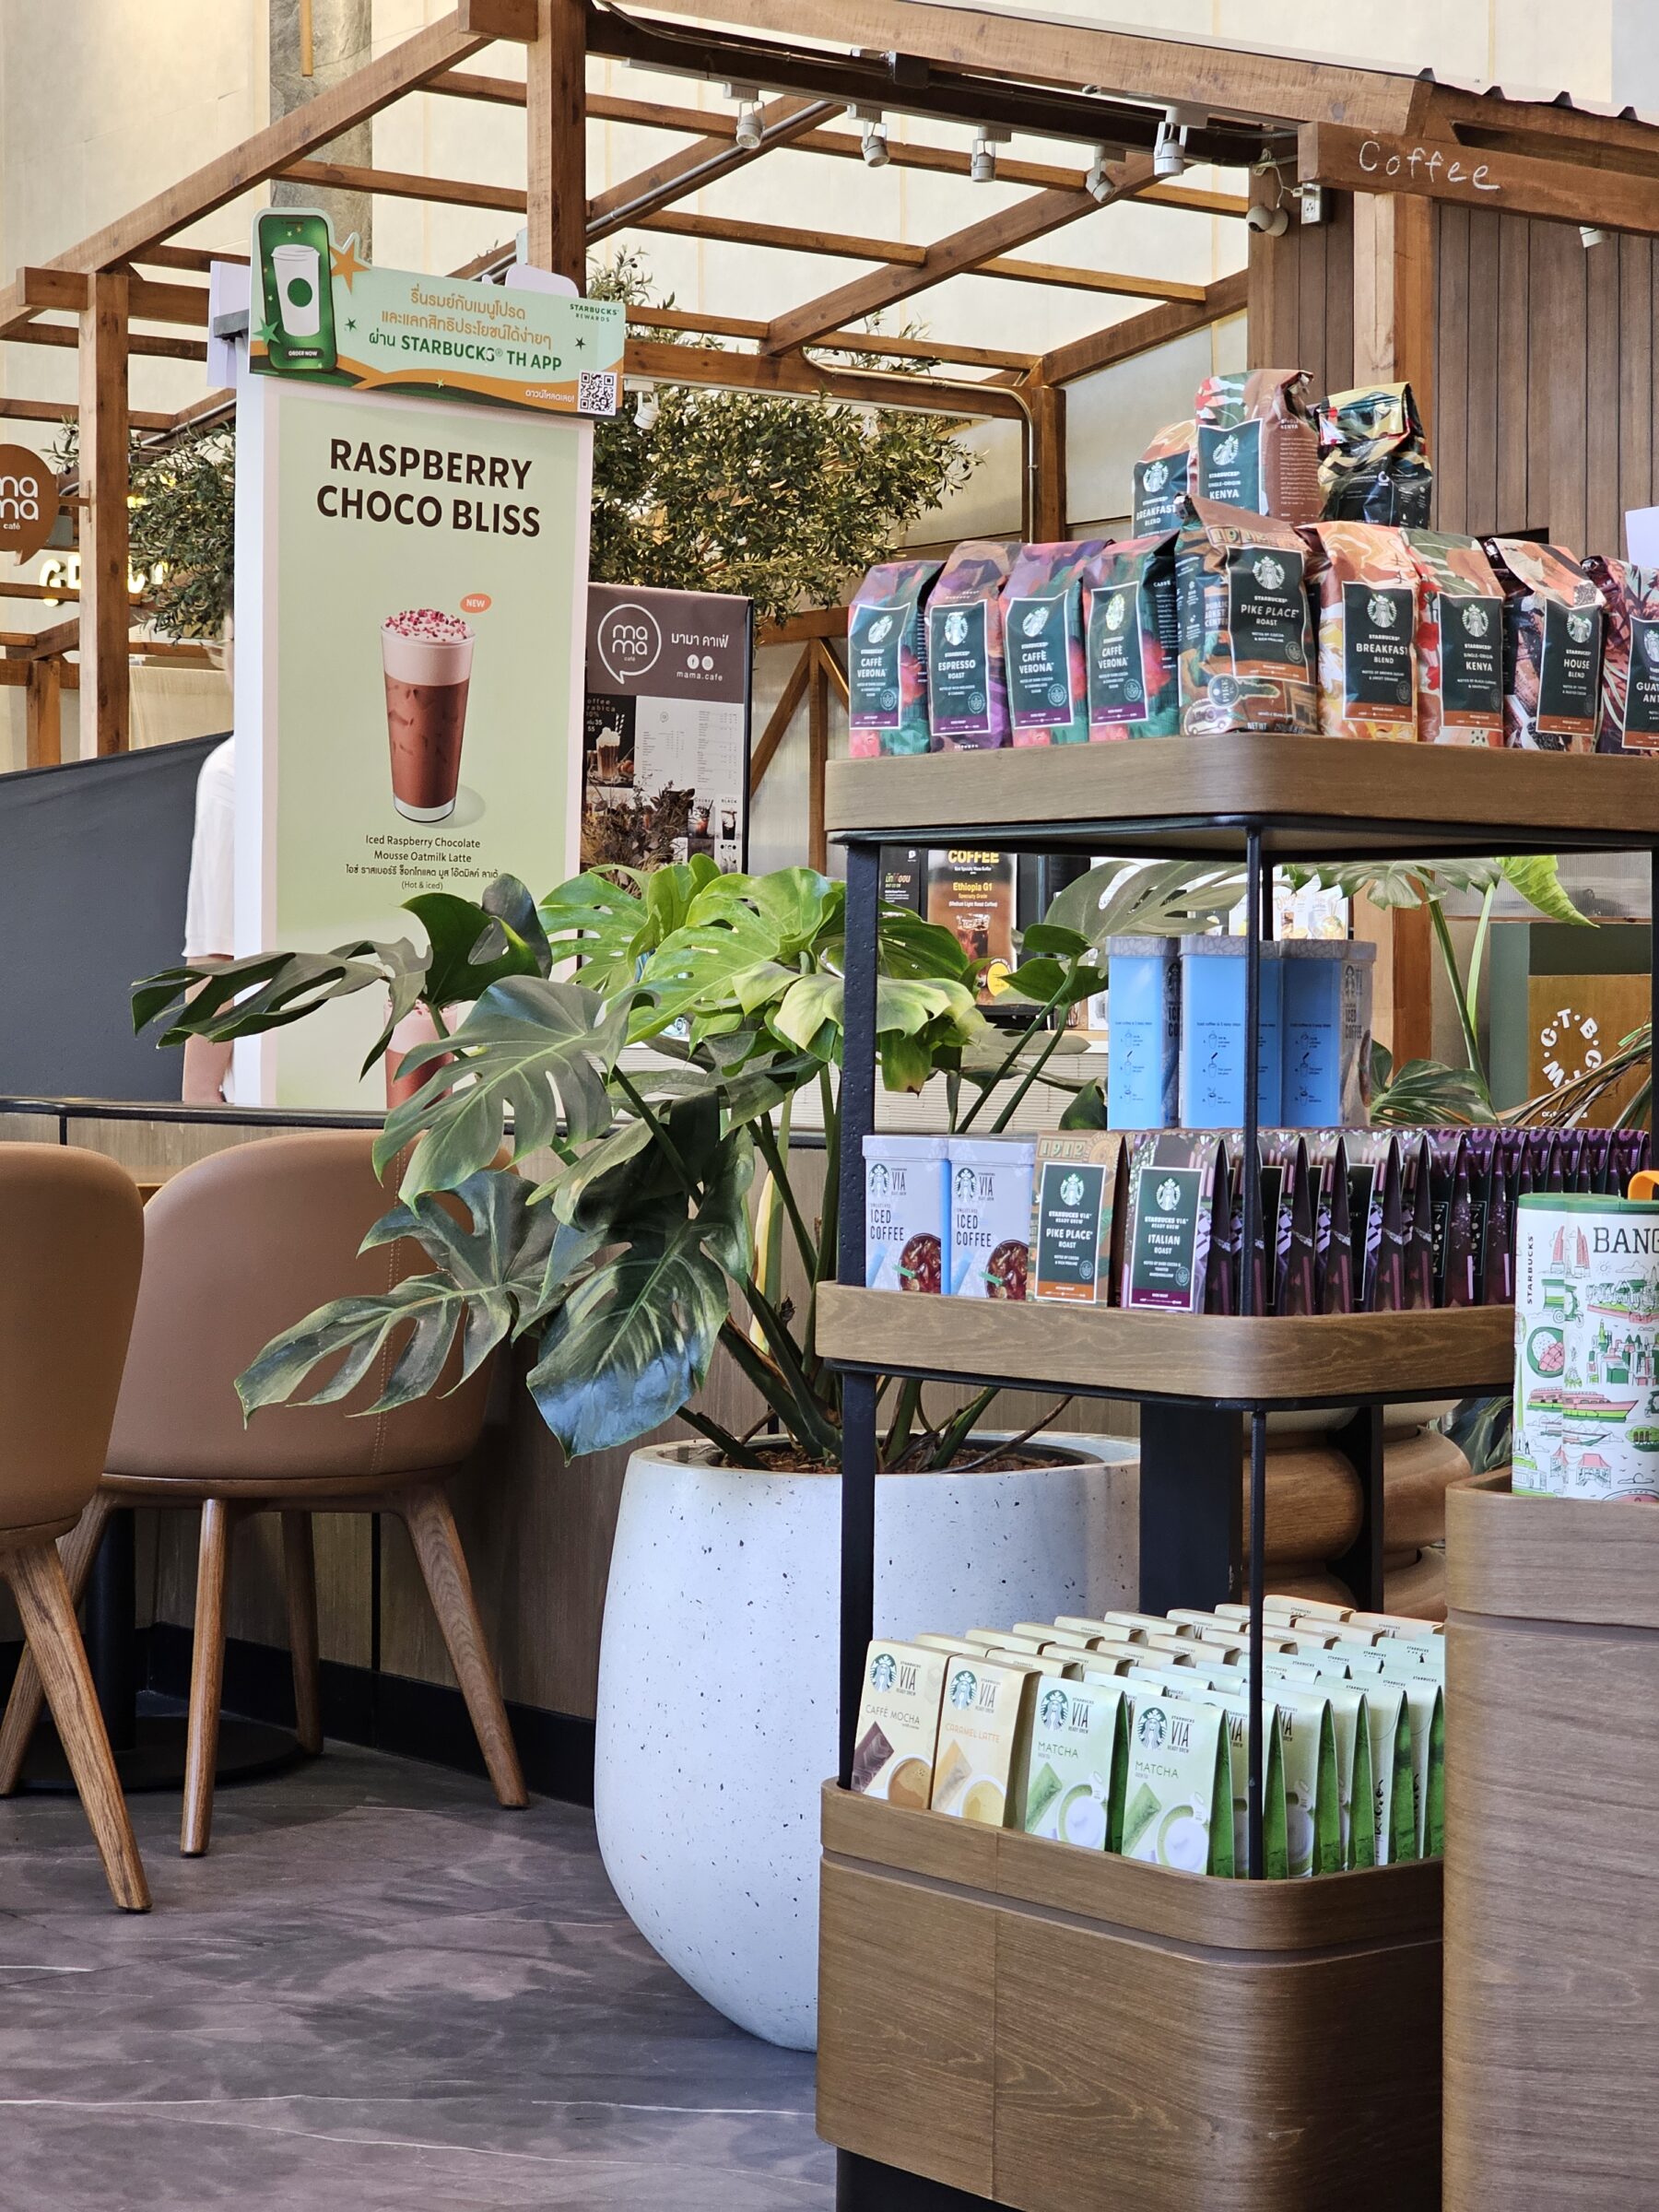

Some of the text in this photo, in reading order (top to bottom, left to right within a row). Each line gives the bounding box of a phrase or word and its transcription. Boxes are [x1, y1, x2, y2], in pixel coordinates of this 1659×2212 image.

[1359, 140, 1500, 191] Coffee
[411, 283, 525, 320] รื่นรมย์กับเมนูโปรด
[576, 312, 610, 323] REWARDS
[382, 311, 552, 349] และแลกสิทธิประโยชน์ได้ง่ายๆ
[370, 328, 395, 347] ผ่าน
[507, 350, 526, 367] TH
[531, 354, 562, 371] APP
[330, 438, 533, 490] RASPBERRY
[1209, 489, 1240, 500] KENYA
[316, 485, 540, 537] CHOCO BLISS
[1136, 504, 1176, 521] BREAKFAST
[466, 598, 486, 608] NEW
[1241, 604, 1264, 615] PIKE
[1255, 618, 1278, 626] ROAST
[612, 624, 648, 641] ma
[612, 640, 648, 656] ma
[671, 632, 729, 649] มามา คาเฟ่
[1022, 650, 1047, 663] CAFFÈ
[1101, 644, 1123, 657] CAFFÈ
[861, 656, 882, 667] CAFFÈ
[938, 660, 976, 672] ESPRESSO
[1465, 661, 1492, 672] KENYA
[1563, 658, 1590, 669] HOUSE
[677, 671, 723, 682] mama.cafe
[365, 835, 481, 849] Iced Raspberry Chocolate
[373, 850, 472, 863] Mousse Oatmilk Latte
[947, 850, 999, 864] COFFEE
[401, 881, 418, 890] (Hot
[426, 882, 443, 890] iced)
[953, 882, 993, 892] Ethiopia G1
[1041, 1139, 1086, 1158] 1912
[892, 1171, 906, 1191] VIA
[980, 1176, 994, 1196] VIA
[871, 1209, 891, 1224] ICED
[957, 1214, 978, 1230] ICED
[870, 1226, 904, 1241] COFFEE
[956, 1231, 992, 1247] COFFEE
[1046, 1228, 1065, 1239] PIKE
[1147, 1234, 1181, 1245] ITALIAN
[1058, 1241, 1077, 1249] ROAST
[900, 1665, 916, 1690] VIA
[979, 1683, 995, 1708] VIA
[890, 1711, 920, 1724] MOCHA
[1072, 1701, 1088, 1728] VIA
[1171, 1715, 1194, 1724] STARBUCKS
[945, 1723, 1000, 1743] CARAMEL LATTE
[1171, 1720, 1189, 1747] VIA
[1038, 1741, 1078, 1759] MATCHA
[1135, 1760, 1179, 1779] MATCHA
